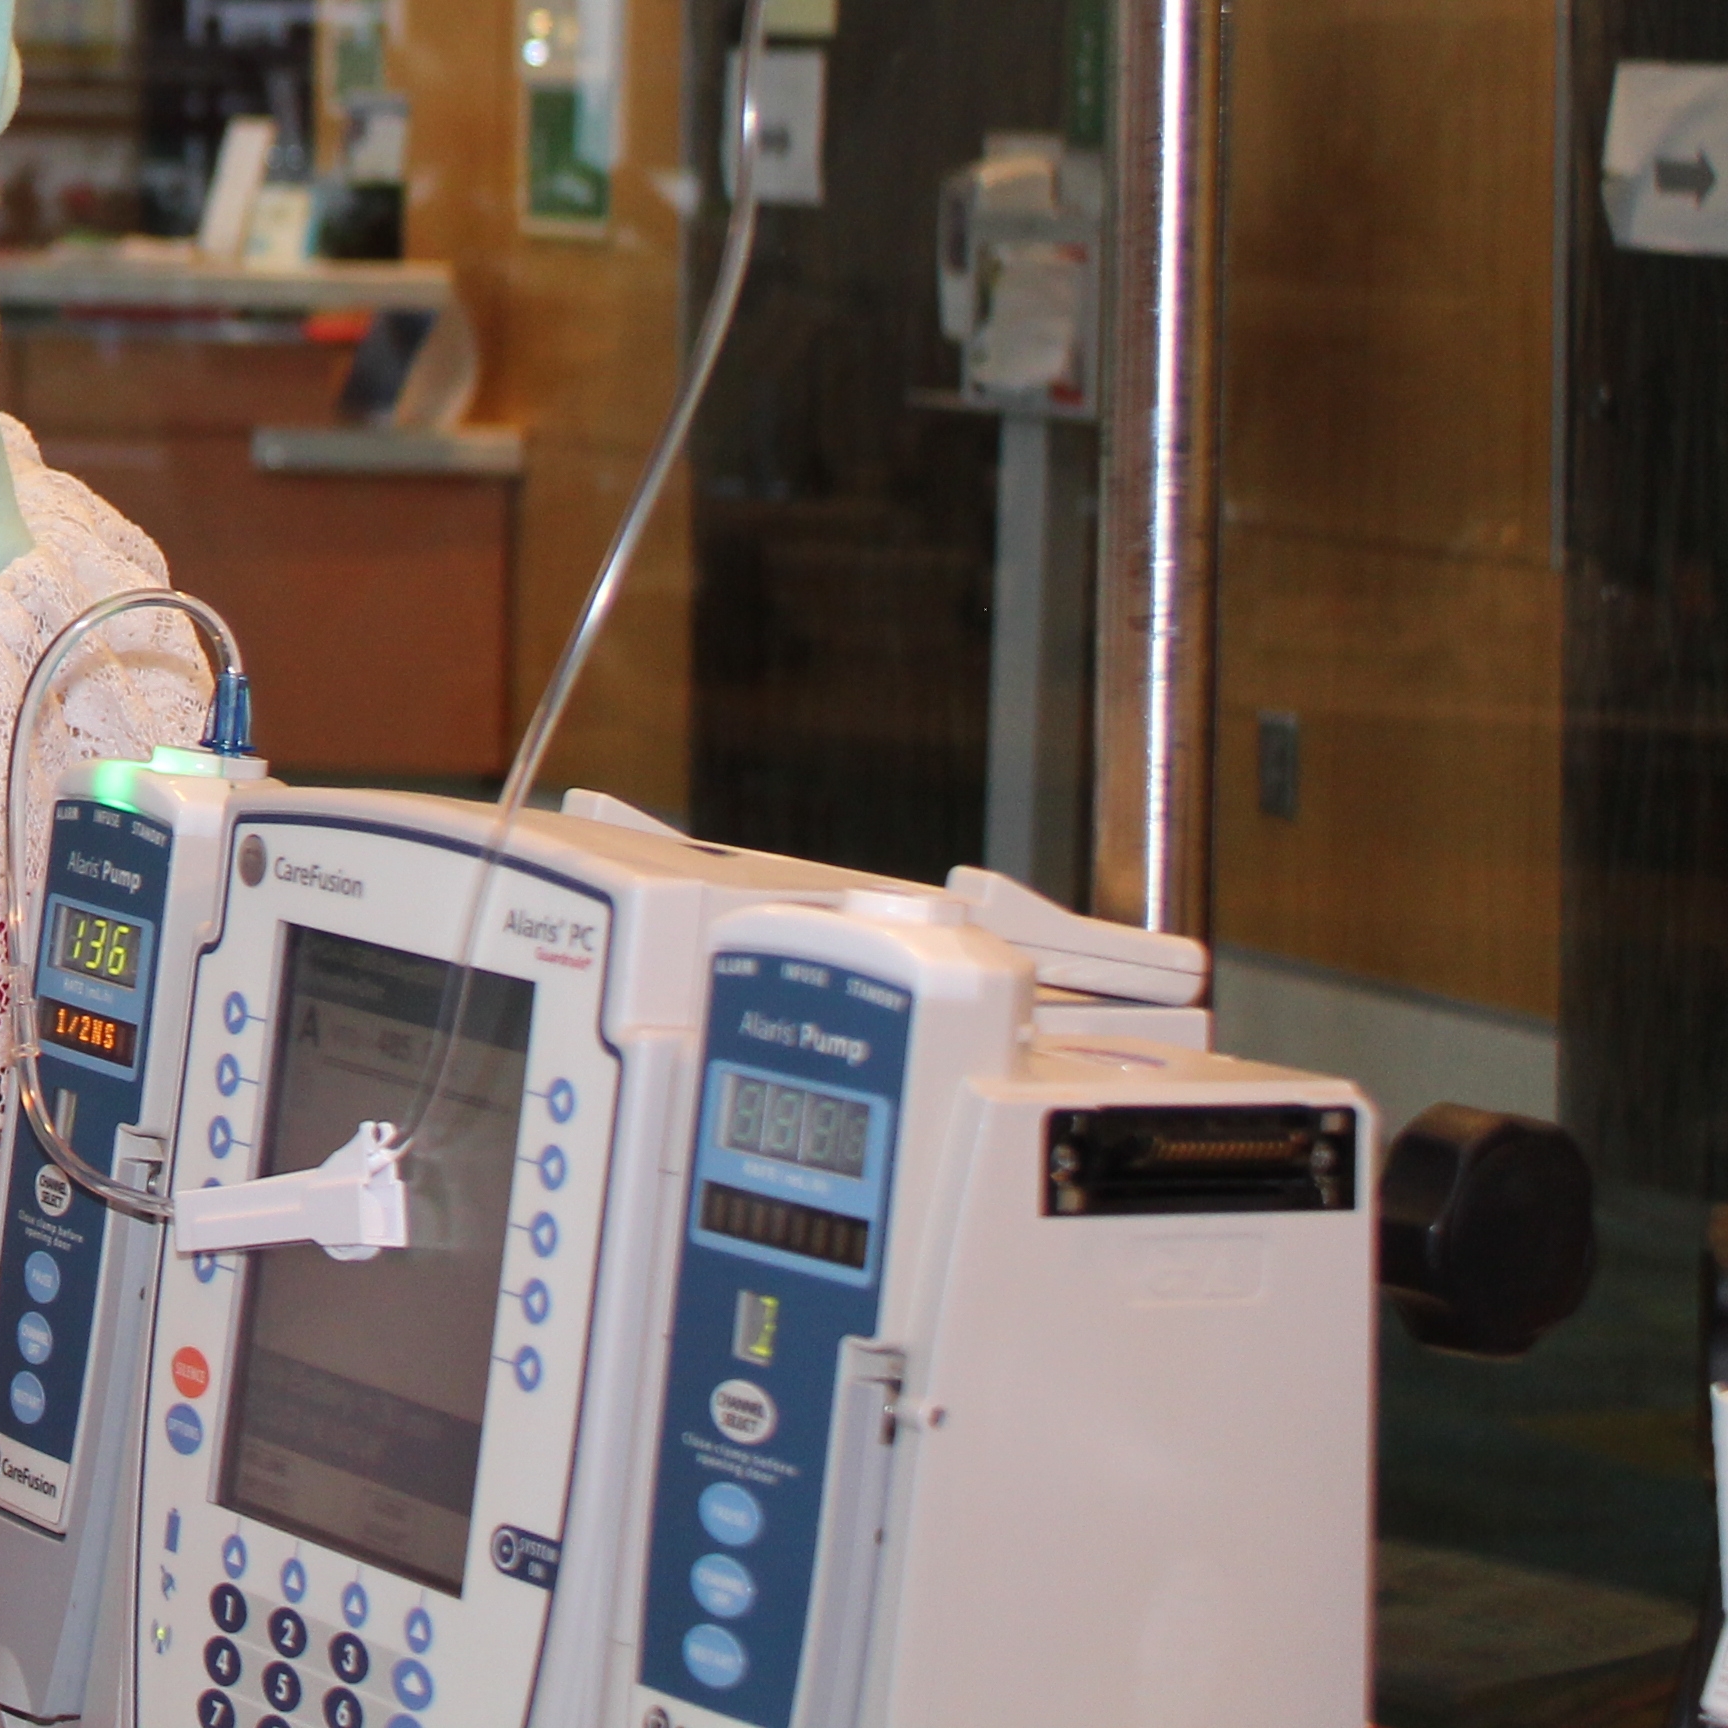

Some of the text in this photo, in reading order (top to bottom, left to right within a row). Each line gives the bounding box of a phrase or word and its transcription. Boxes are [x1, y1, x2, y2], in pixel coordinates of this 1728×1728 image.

[101, 860, 143, 895] Pump
[274, 857, 364, 898] CareFusion
[73, 919, 131, 976] 136
[569, 923, 595, 952] PC
[799, 1022, 872, 1067] Pump
[1, 1458, 57, 1499] CareFusion
[224, 1593, 357, 1673] 1 2 3
[215, 1648, 350, 1727] 4 5 6
[209, 1699, 226, 1726] 7
